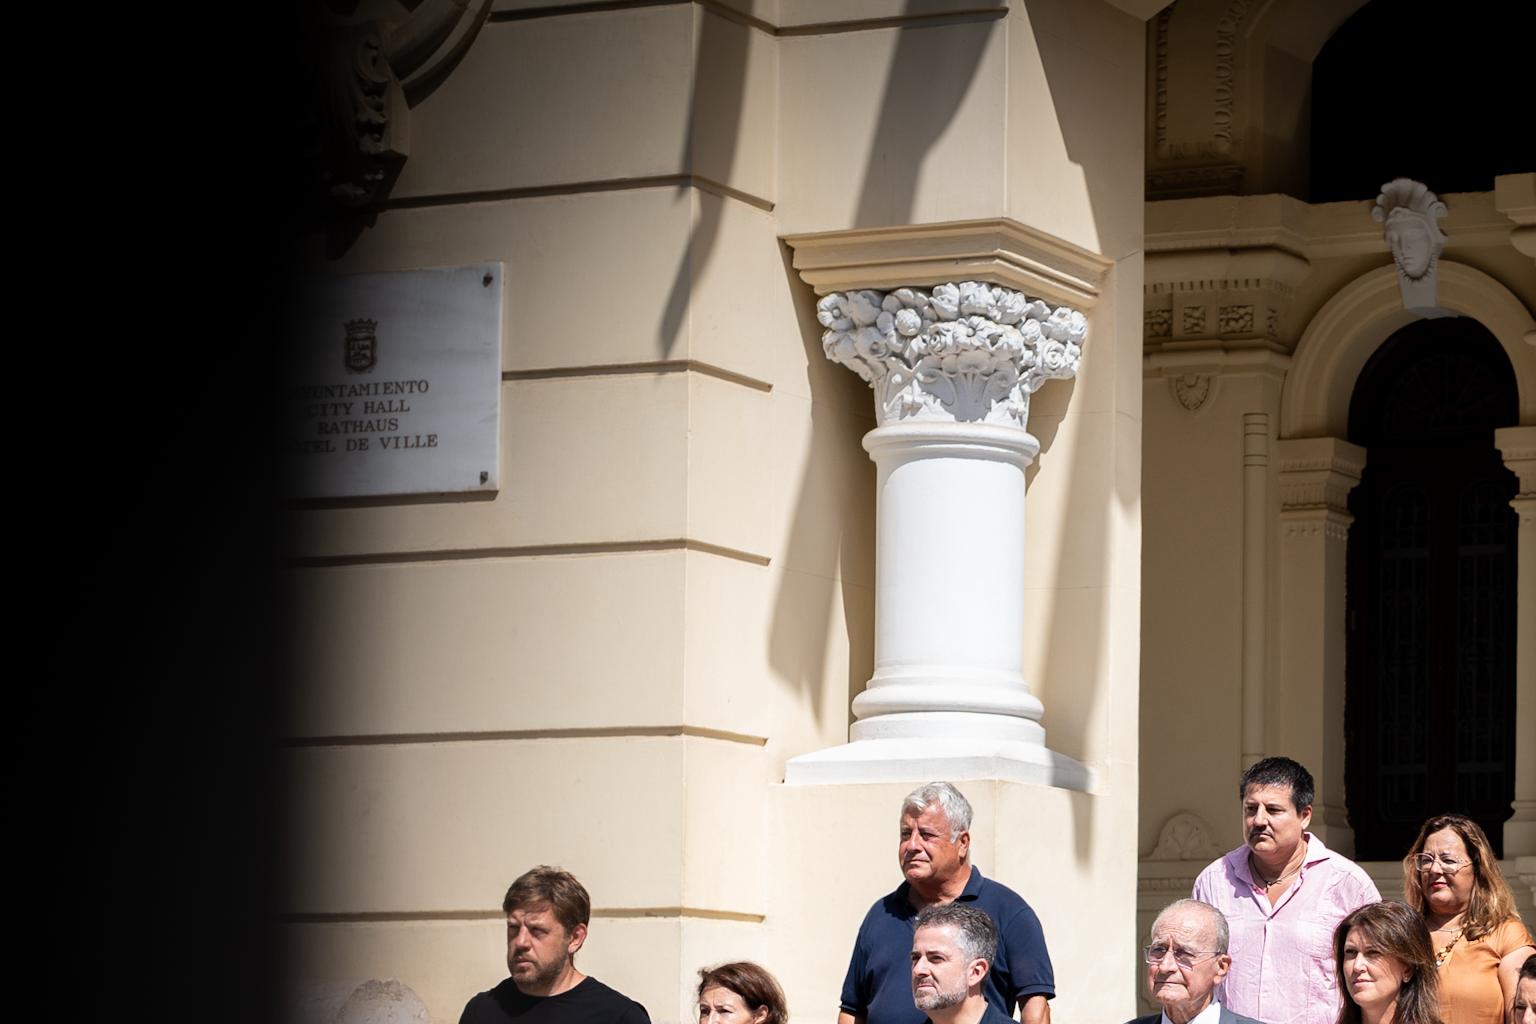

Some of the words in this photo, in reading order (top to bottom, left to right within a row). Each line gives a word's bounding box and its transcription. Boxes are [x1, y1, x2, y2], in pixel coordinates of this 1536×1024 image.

[290, 379, 429, 399] YUNTAMIENTO
[364, 400, 411, 415] HALL
[317, 418, 399, 435] RATHAUS
[346, 438, 369, 451] DE
[379, 434, 438, 449] VILLE
